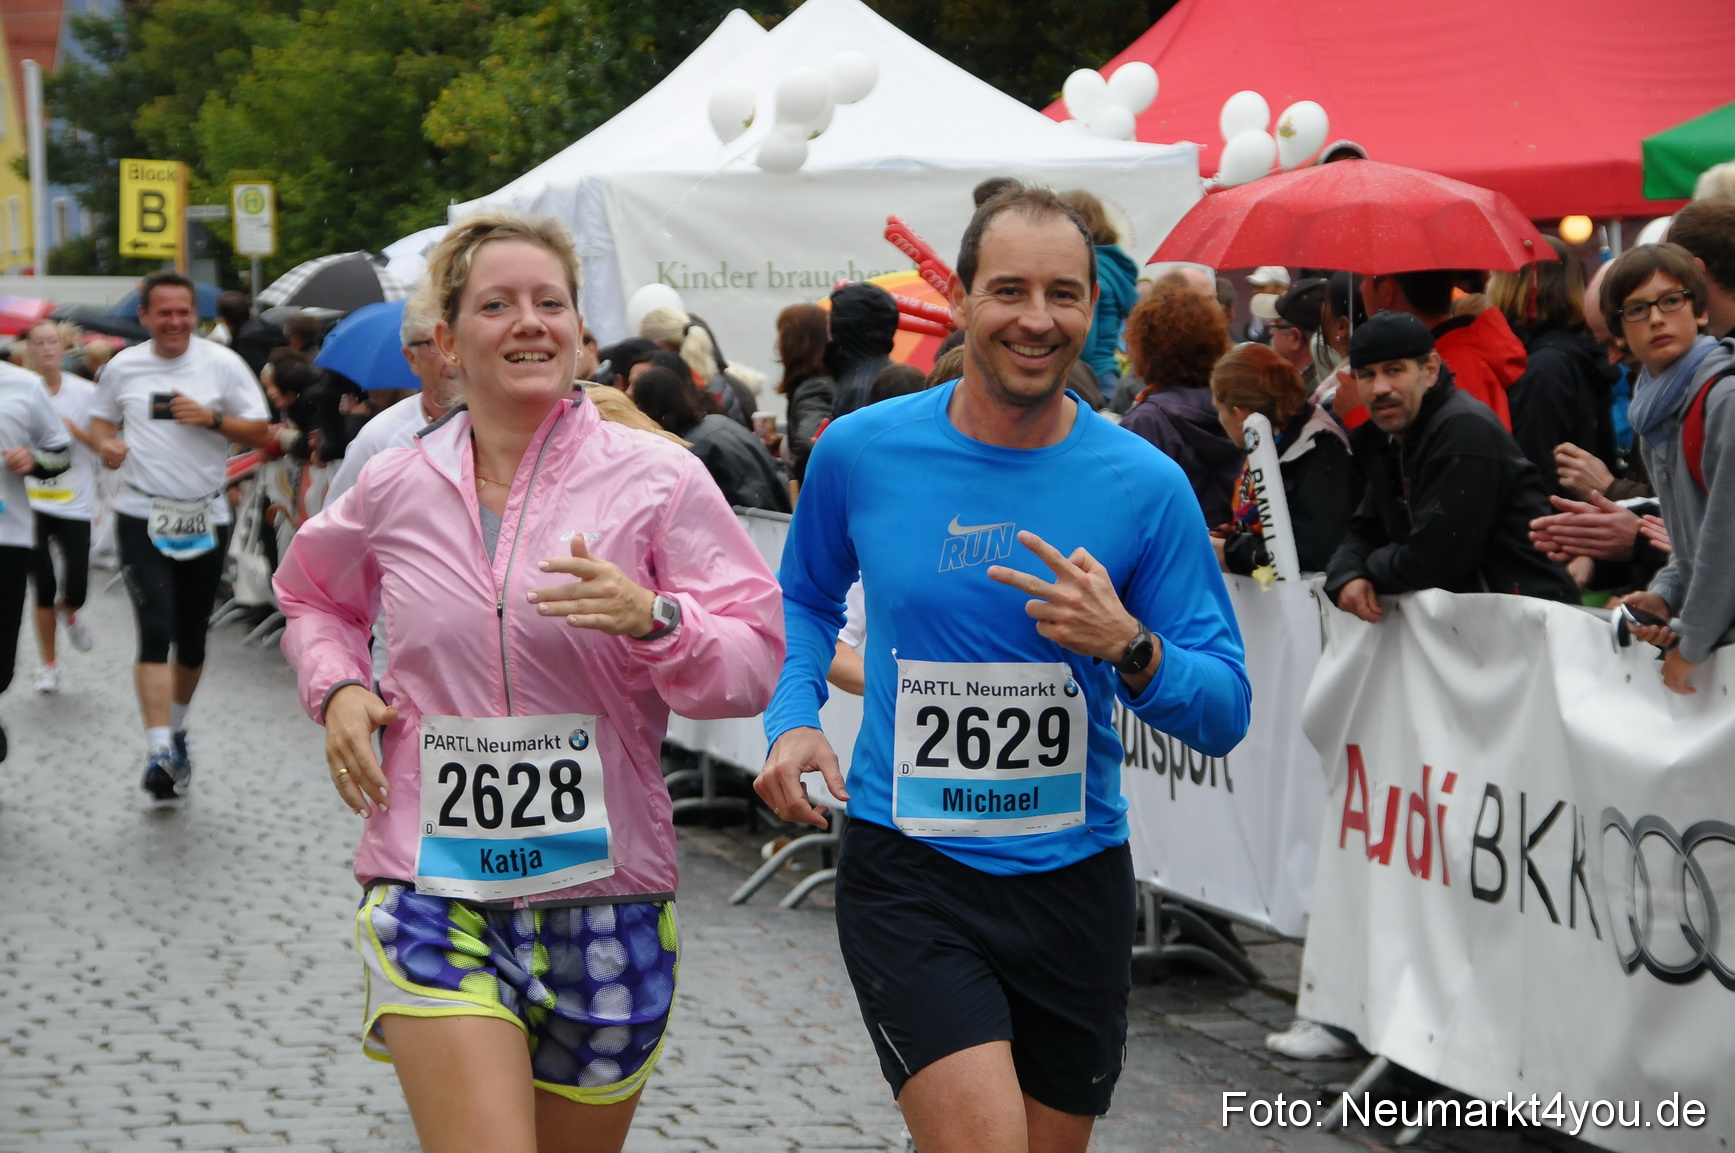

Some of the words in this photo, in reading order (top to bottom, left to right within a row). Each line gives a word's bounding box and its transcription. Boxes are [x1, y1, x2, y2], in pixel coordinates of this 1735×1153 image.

[128, 163, 178, 181] Block
[138, 189, 167, 233] B
[656, 260, 757, 289] Kinder
[767, 259, 897, 289] brauche
[155, 512, 206, 535] 2488
[938, 522, 1016, 573] RUN
[900, 678, 961, 696] PARTL
[966, 681, 1056, 697] Neumarkt
[424, 734, 474, 752] PARTL
[477, 734, 561, 753] Neumarkt
[915, 705, 1071, 770] 2629
[438, 758, 586, 830] 2628
[942, 786, 1039, 813] Michael
[1340, 744, 1459, 887] Audi
[1470, 782, 1603, 941] BKK
[480, 848, 543, 876] Katja
